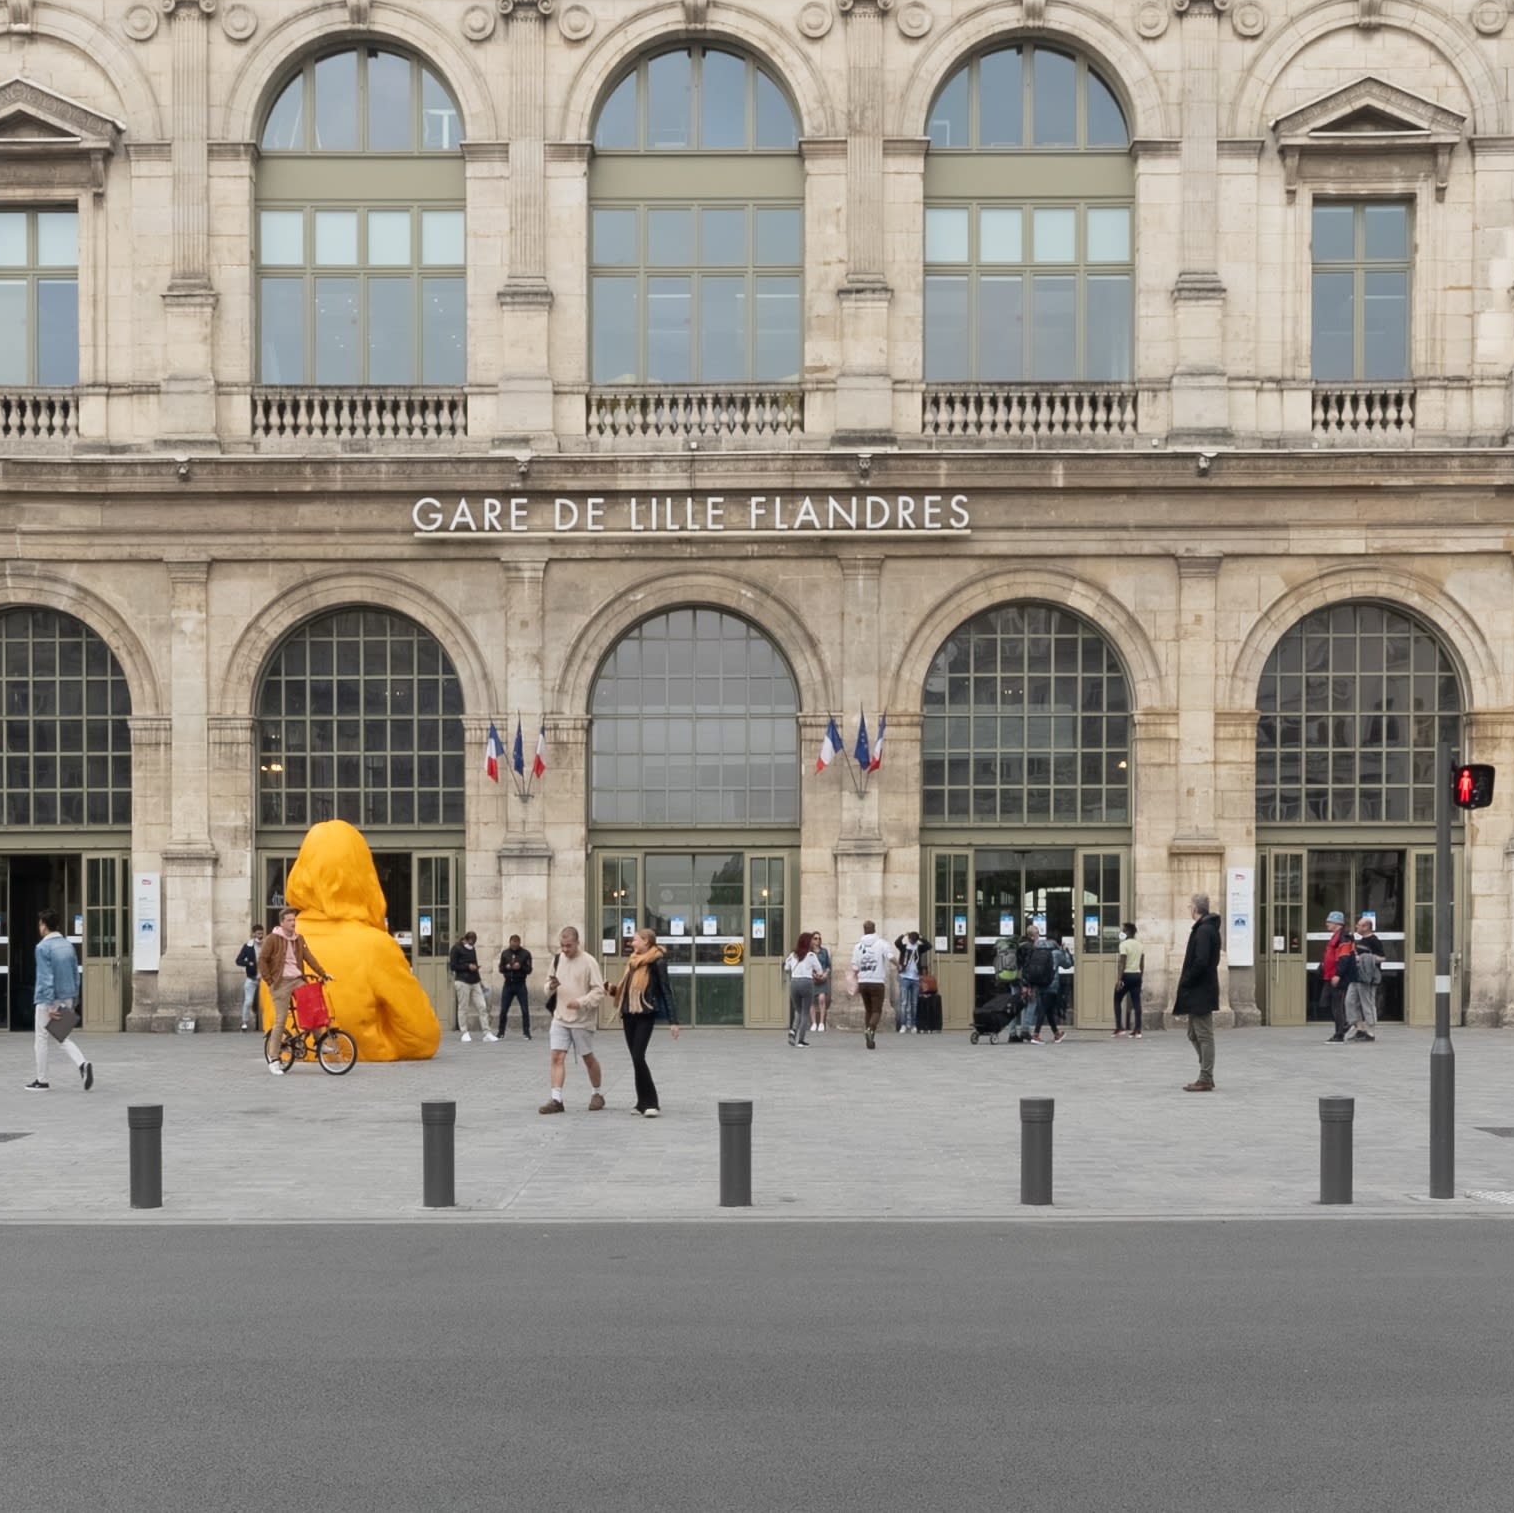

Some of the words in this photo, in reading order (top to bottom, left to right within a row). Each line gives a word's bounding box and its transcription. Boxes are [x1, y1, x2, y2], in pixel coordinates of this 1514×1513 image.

[411, 497, 529, 531] GARE
[554, 497, 605, 531] DE
[629, 497, 725, 530] LILLE
[749, 494, 970, 530] FLANDRES
